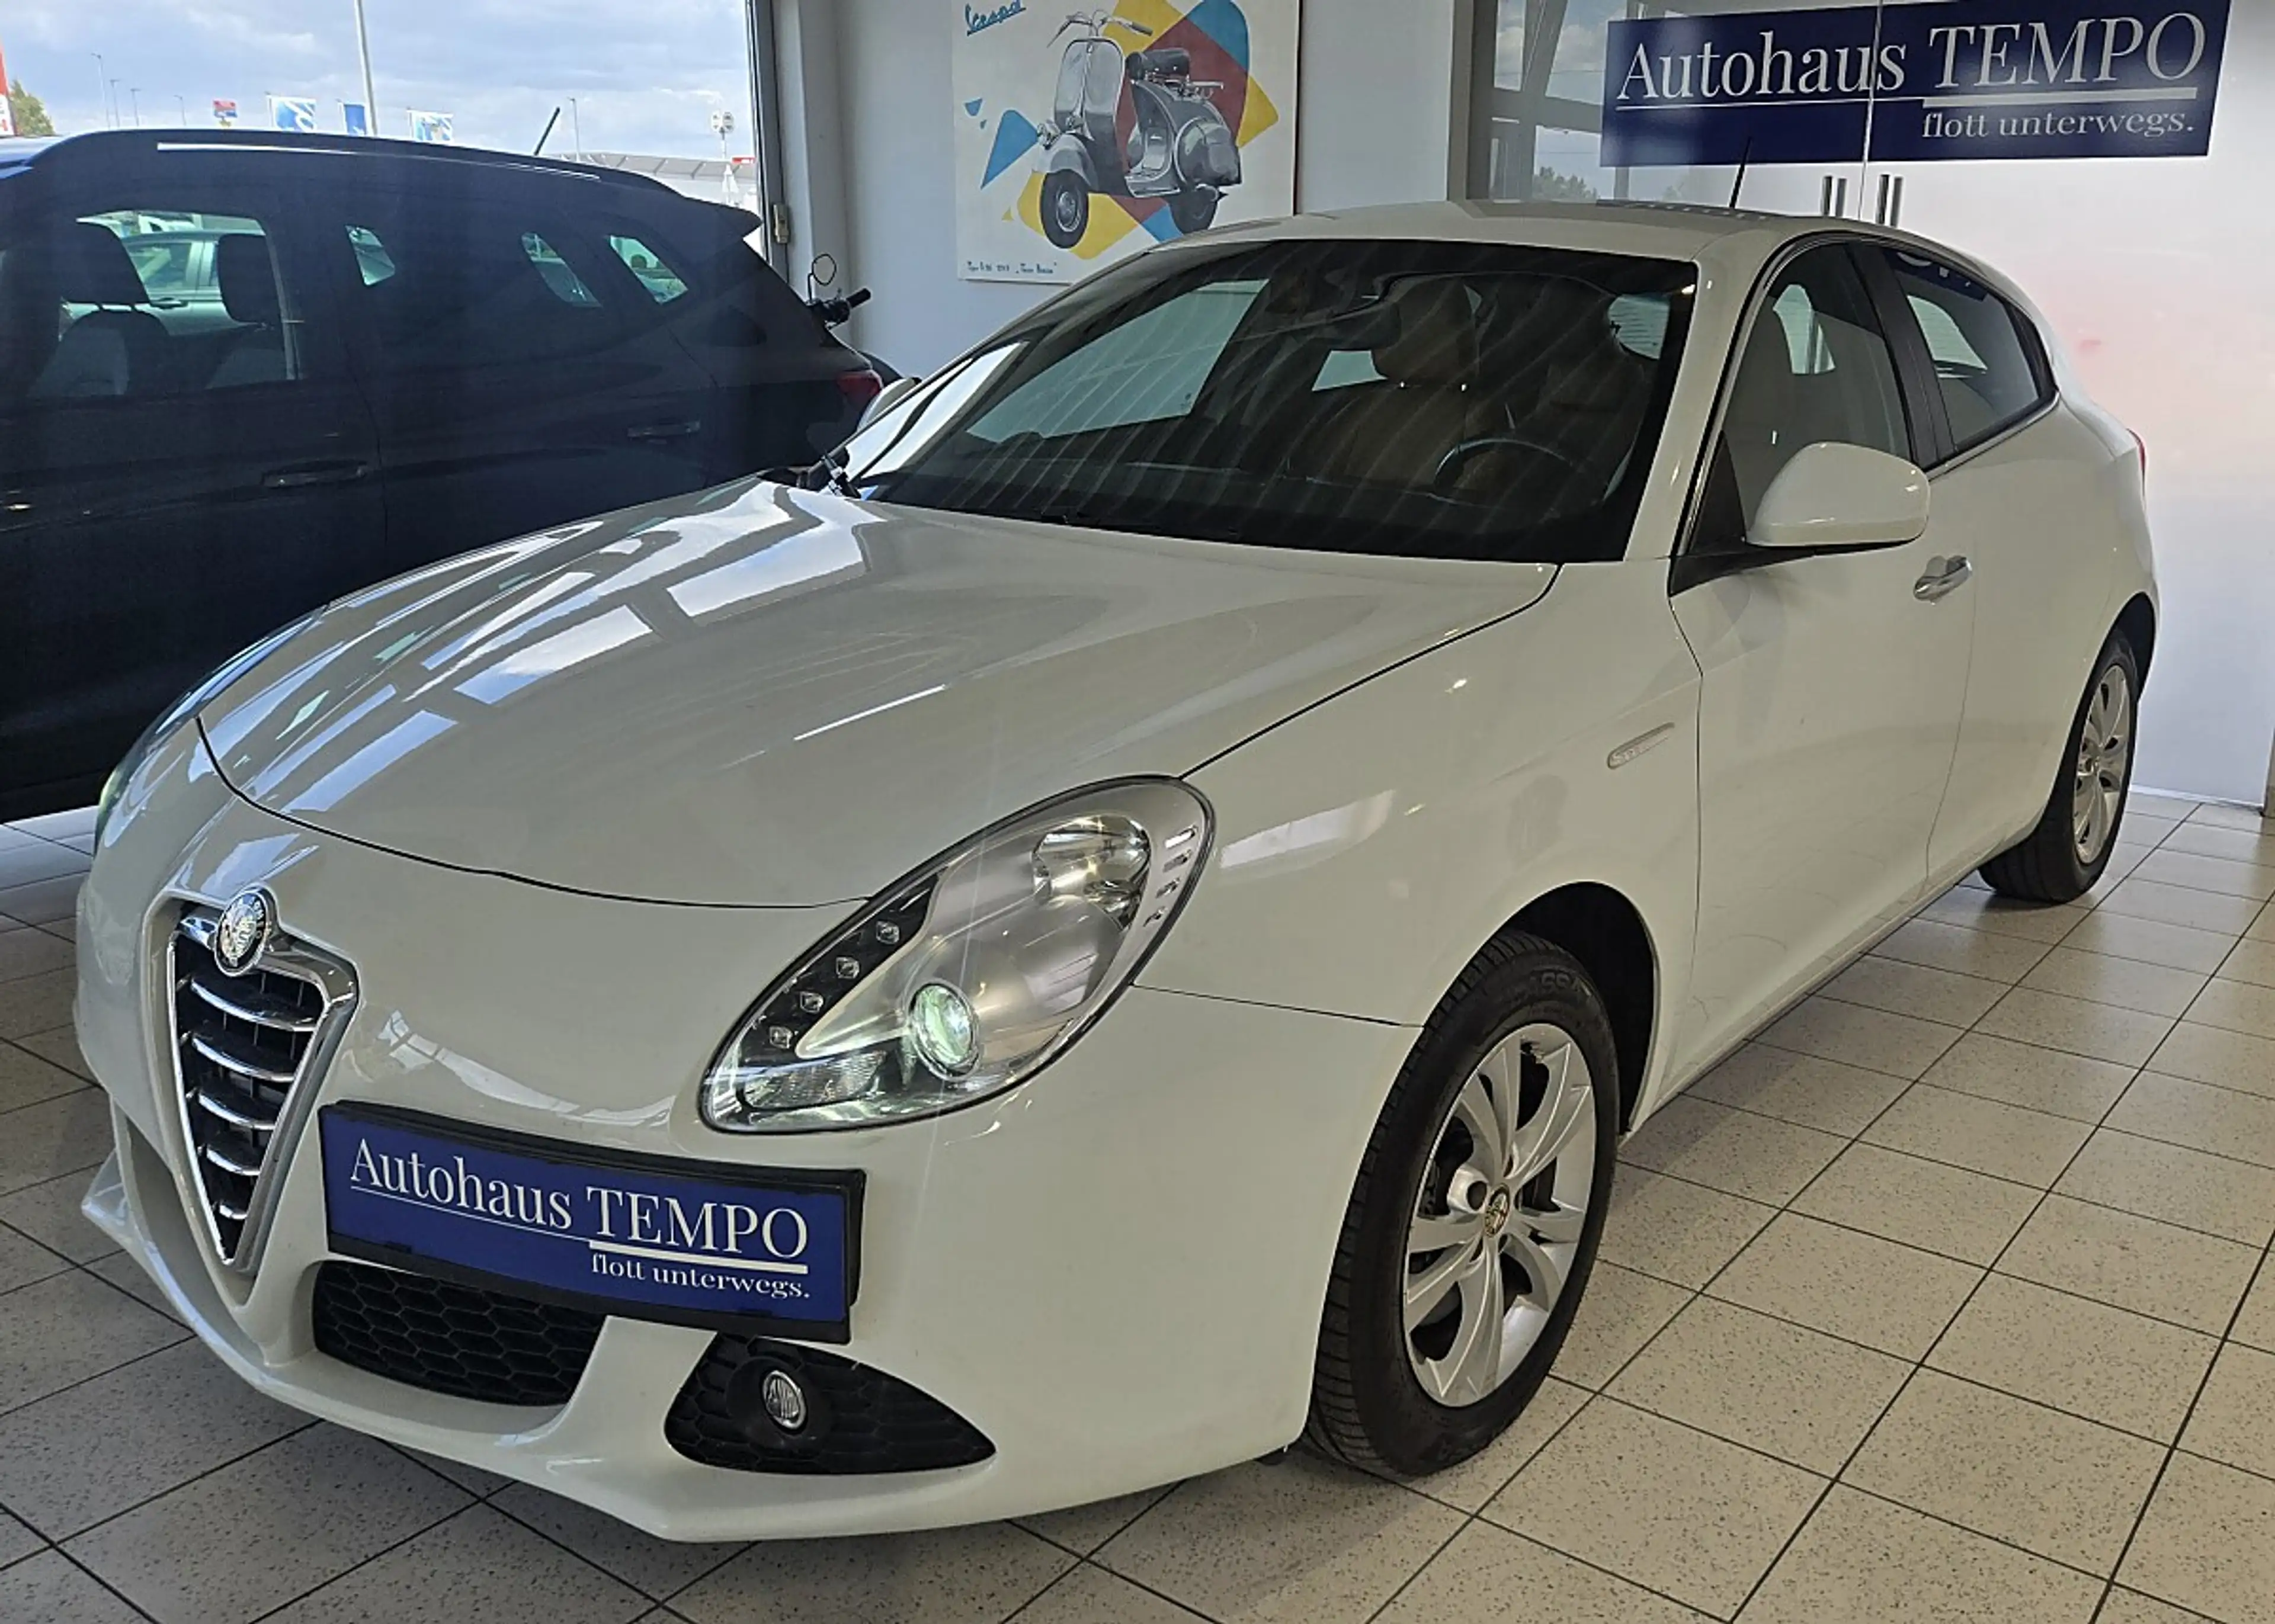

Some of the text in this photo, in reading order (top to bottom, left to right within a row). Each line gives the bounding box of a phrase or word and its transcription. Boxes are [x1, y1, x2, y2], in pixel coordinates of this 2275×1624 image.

[1617, 13, 2204, 100] Autohaus TEMPO
[1922, 112, 2194, 137] flott unterwegs.
[350, 1138, 808, 1259] Autohaus TEMPO
[592, 1253, 810, 1299] flott unterwegs.
